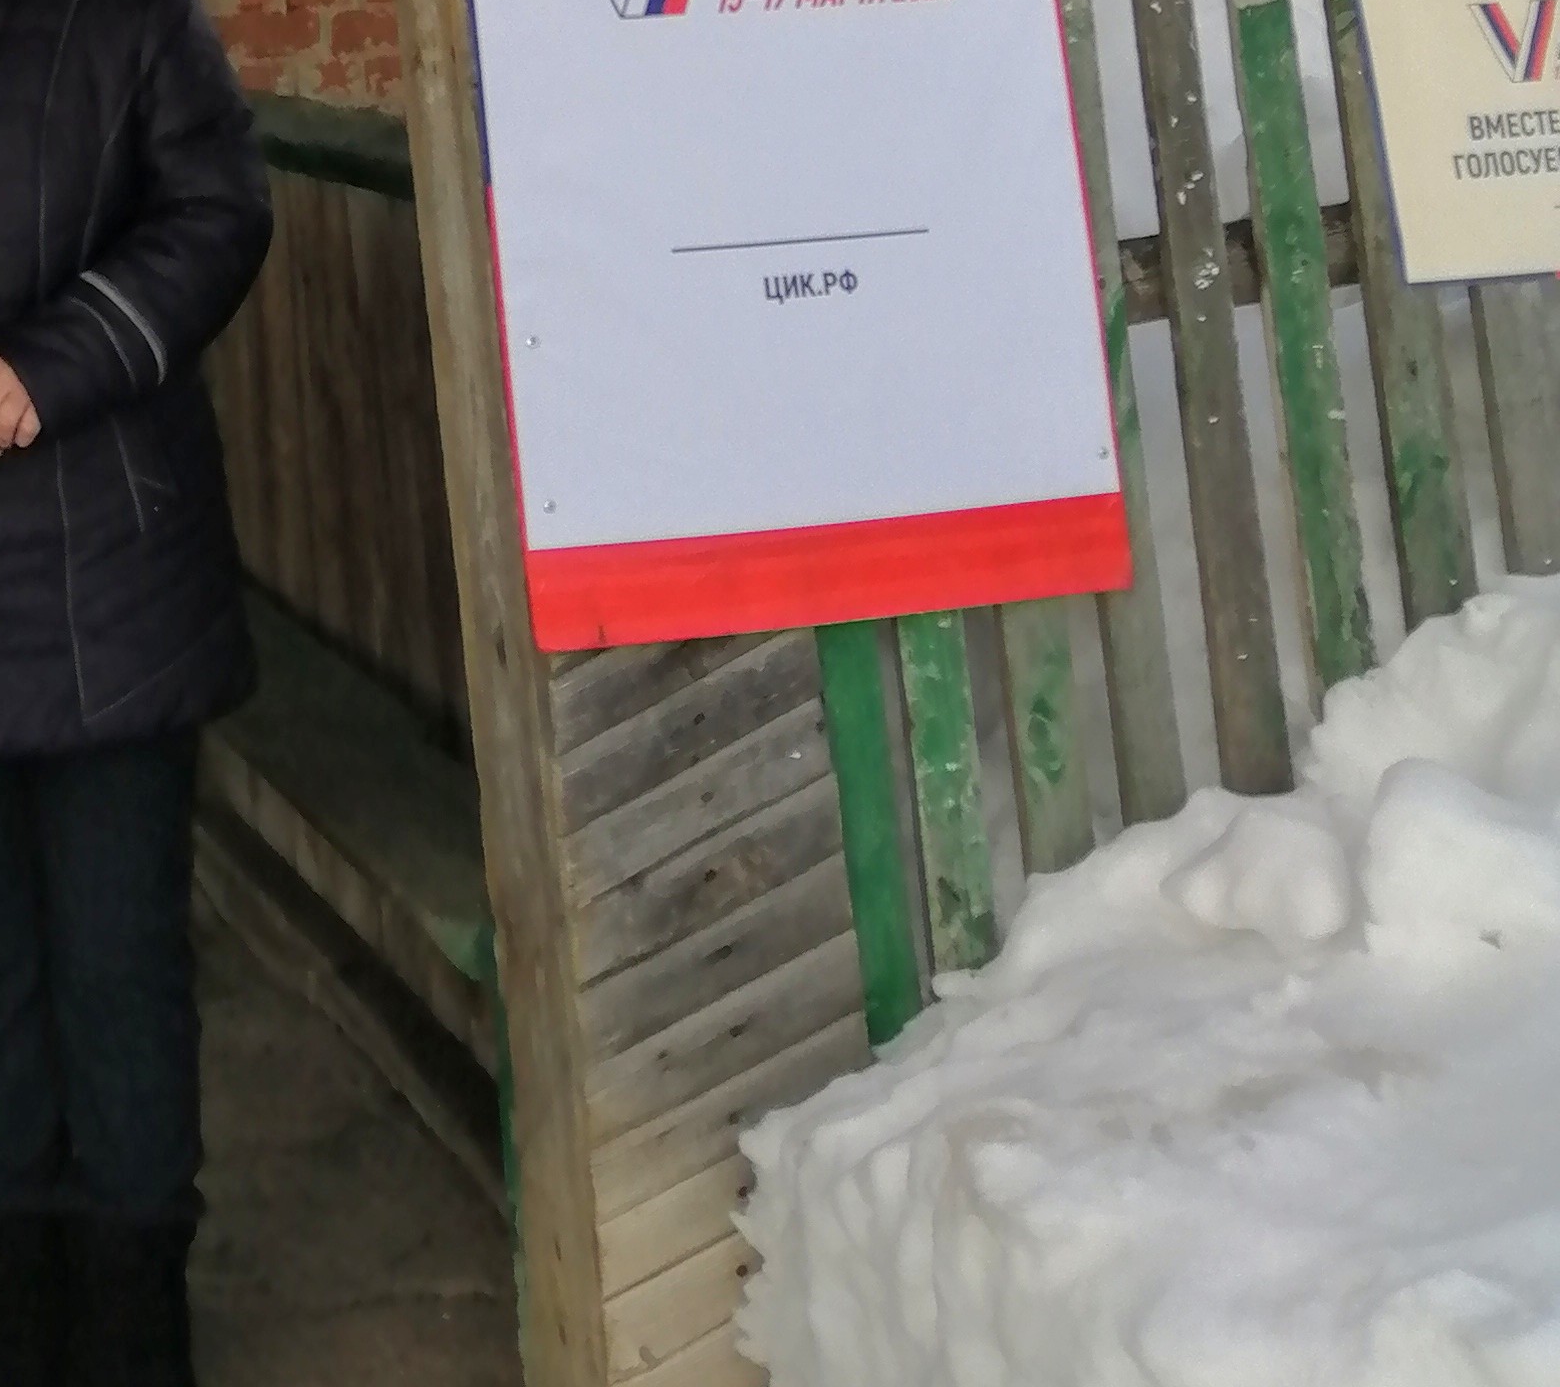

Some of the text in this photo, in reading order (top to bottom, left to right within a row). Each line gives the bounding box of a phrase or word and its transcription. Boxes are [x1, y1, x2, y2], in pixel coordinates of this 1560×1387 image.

[1468, 110, 1560, 141] ВМЕСТЕ
[1453, 147, 1560, 180] ГОЛОСУЕ
[764, 269, 858, 304] ЦИК.РФ
